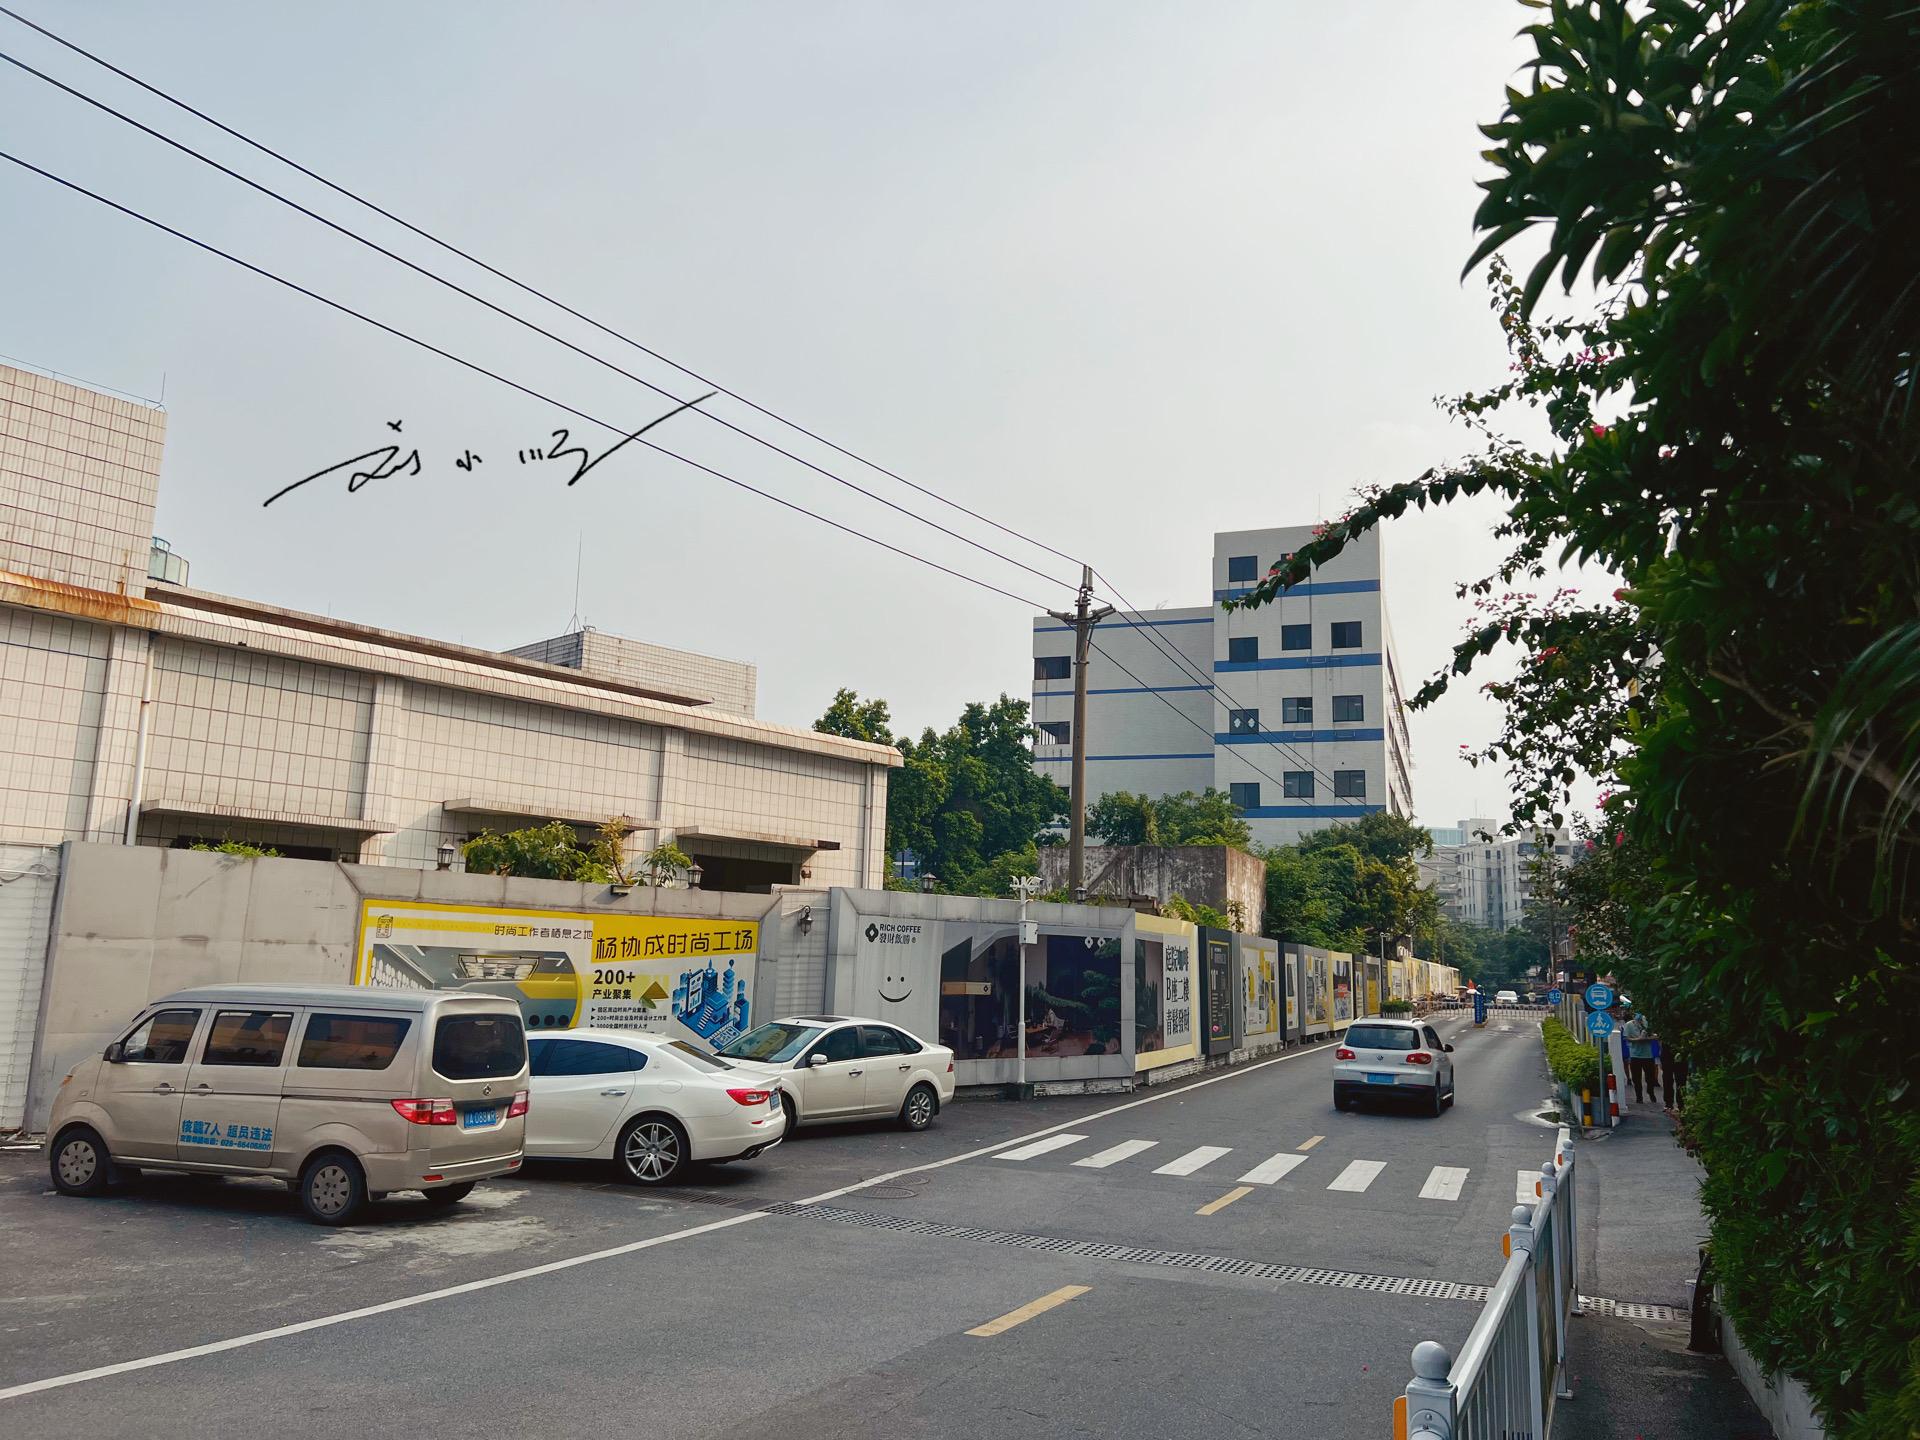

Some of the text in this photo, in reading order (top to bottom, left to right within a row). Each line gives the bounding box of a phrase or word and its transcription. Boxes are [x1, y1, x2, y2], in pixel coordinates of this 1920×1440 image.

[494, 925, 594, 941] 时尚工作者栖息之地
[879, 924, 921, 934] RICH COFFEE
[594, 930, 753, 960] 杨协成时尚工场
[593, 969, 636, 985] 200+
[591, 988, 632, 1000] 产业聚集
[181, 1119, 273, 1141] 核载7人 超员违法
